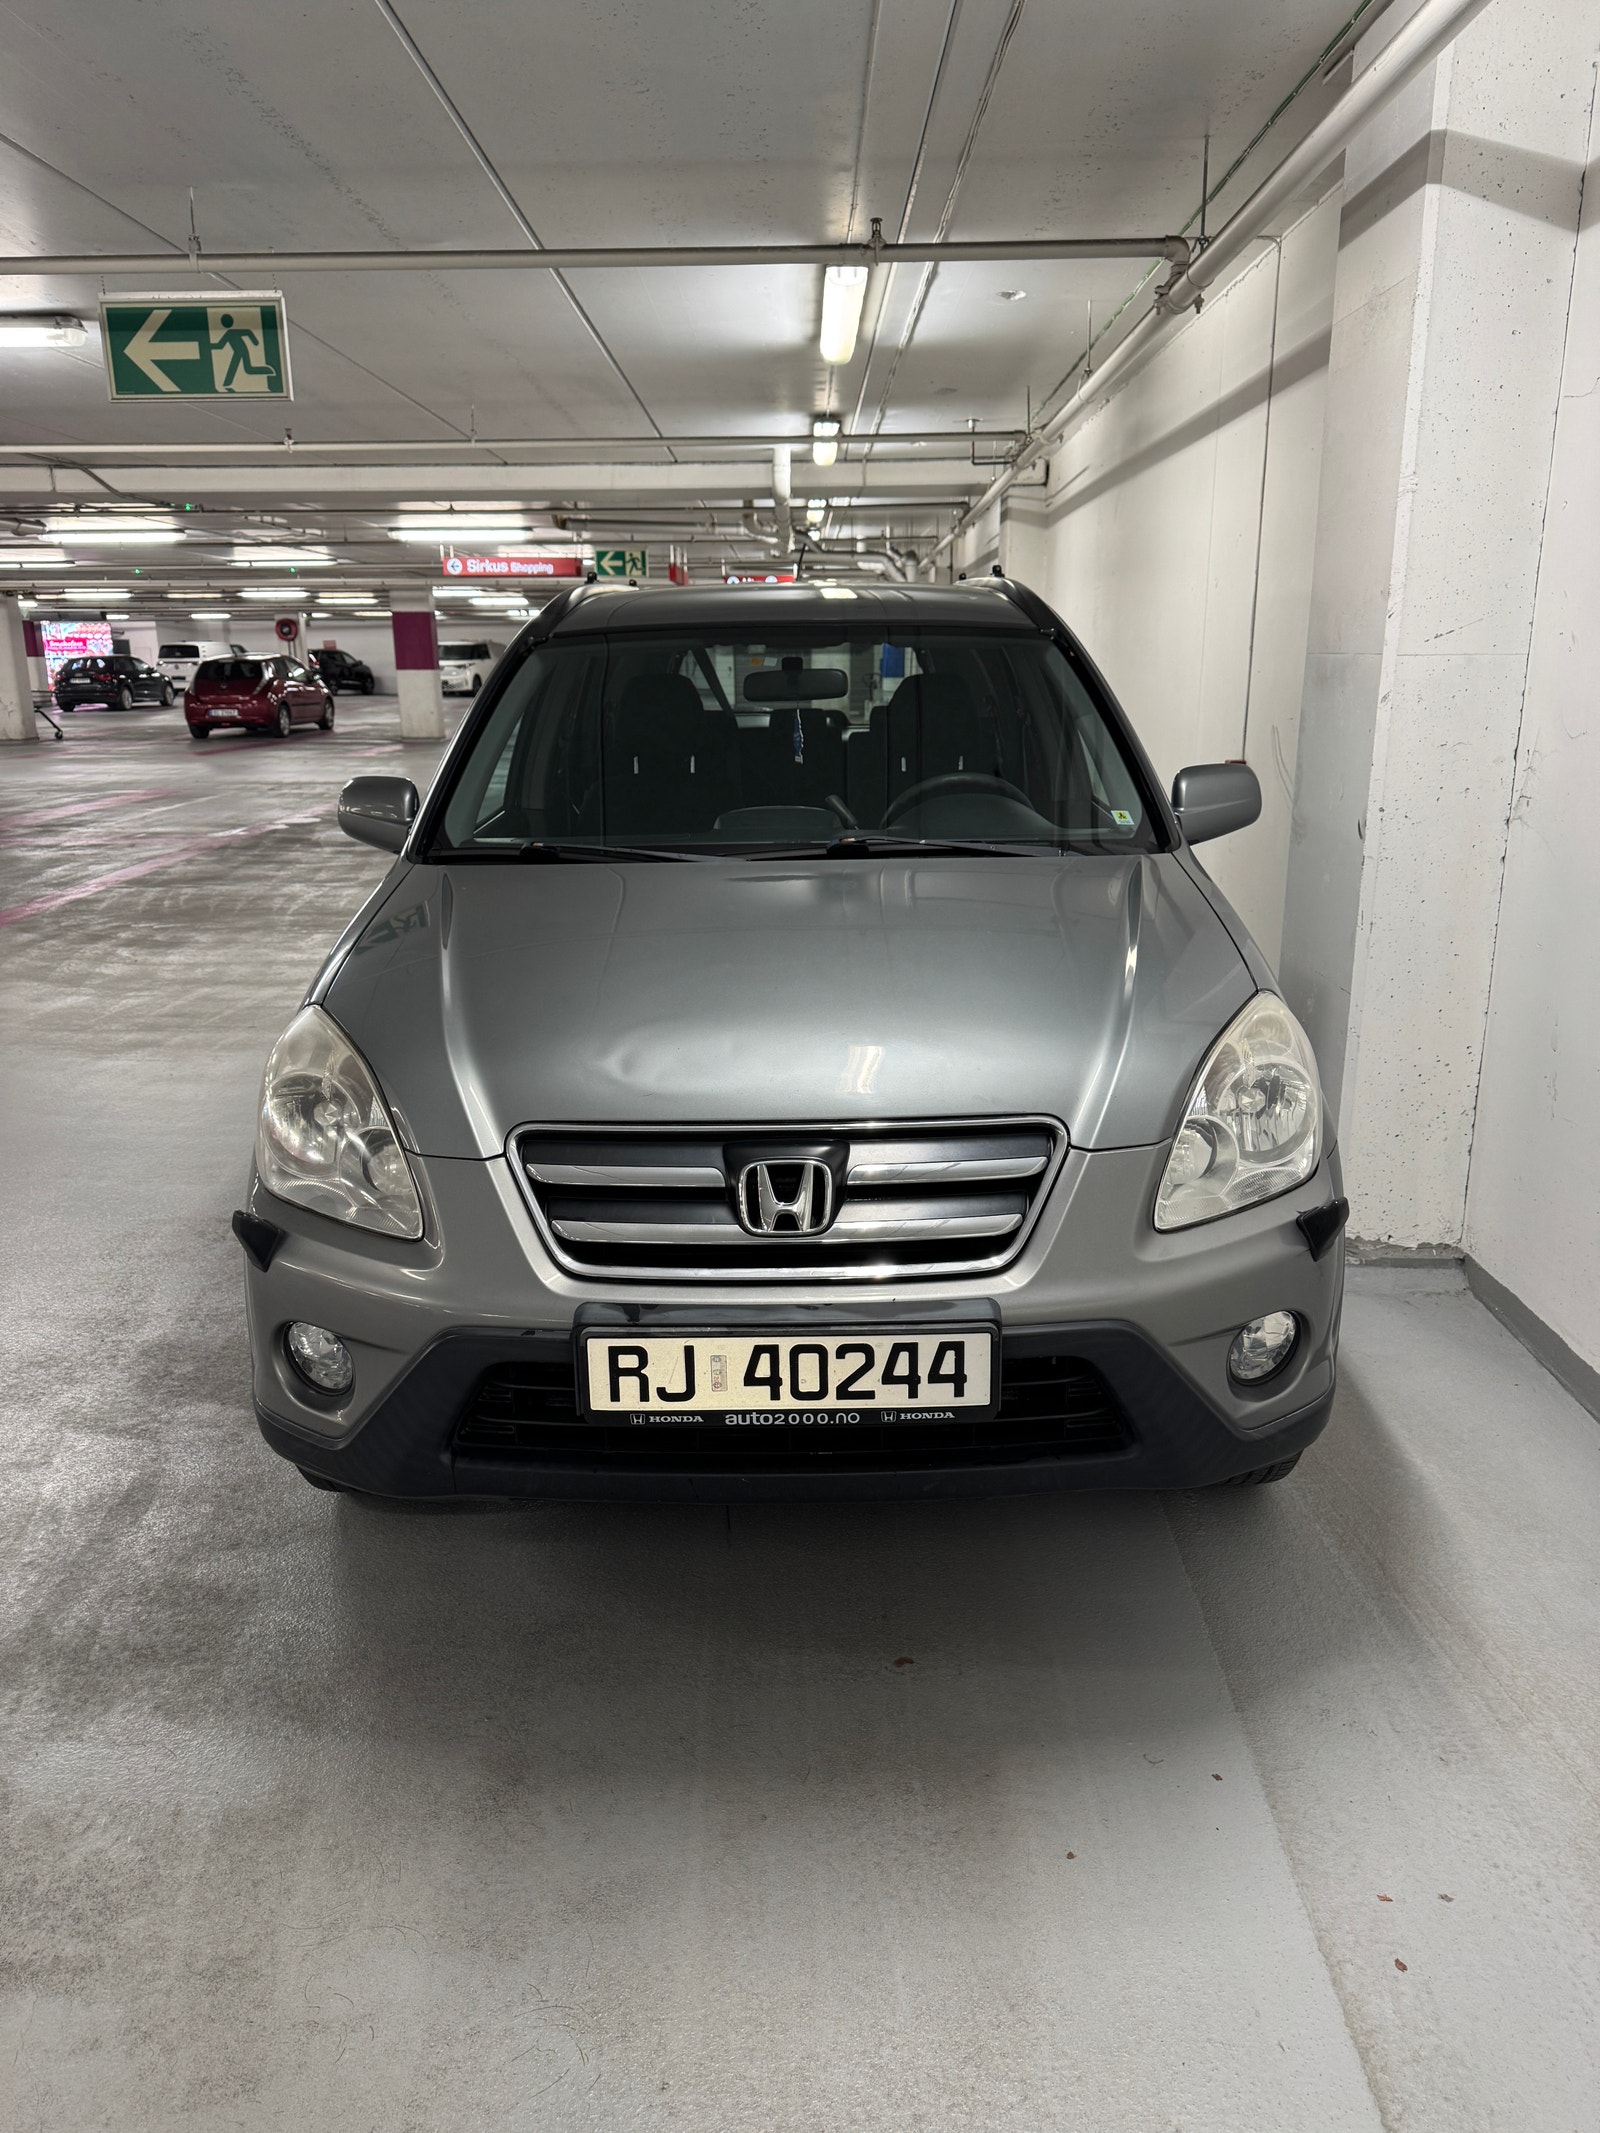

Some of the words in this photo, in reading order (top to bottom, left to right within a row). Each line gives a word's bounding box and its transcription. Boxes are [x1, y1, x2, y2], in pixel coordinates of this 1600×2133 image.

[467, 559, 508, 573] Sirkus
[510, 561, 554, 575] Shopping
[608, 1345, 695, 1402] RJ
[743, 1341, 967, 1401] 40244
[648, 1415, 704, 1423] HONDA
[725, 1412, 861, 1426] auto2000.no
[899, 1412, 955, 1420] HONDA
